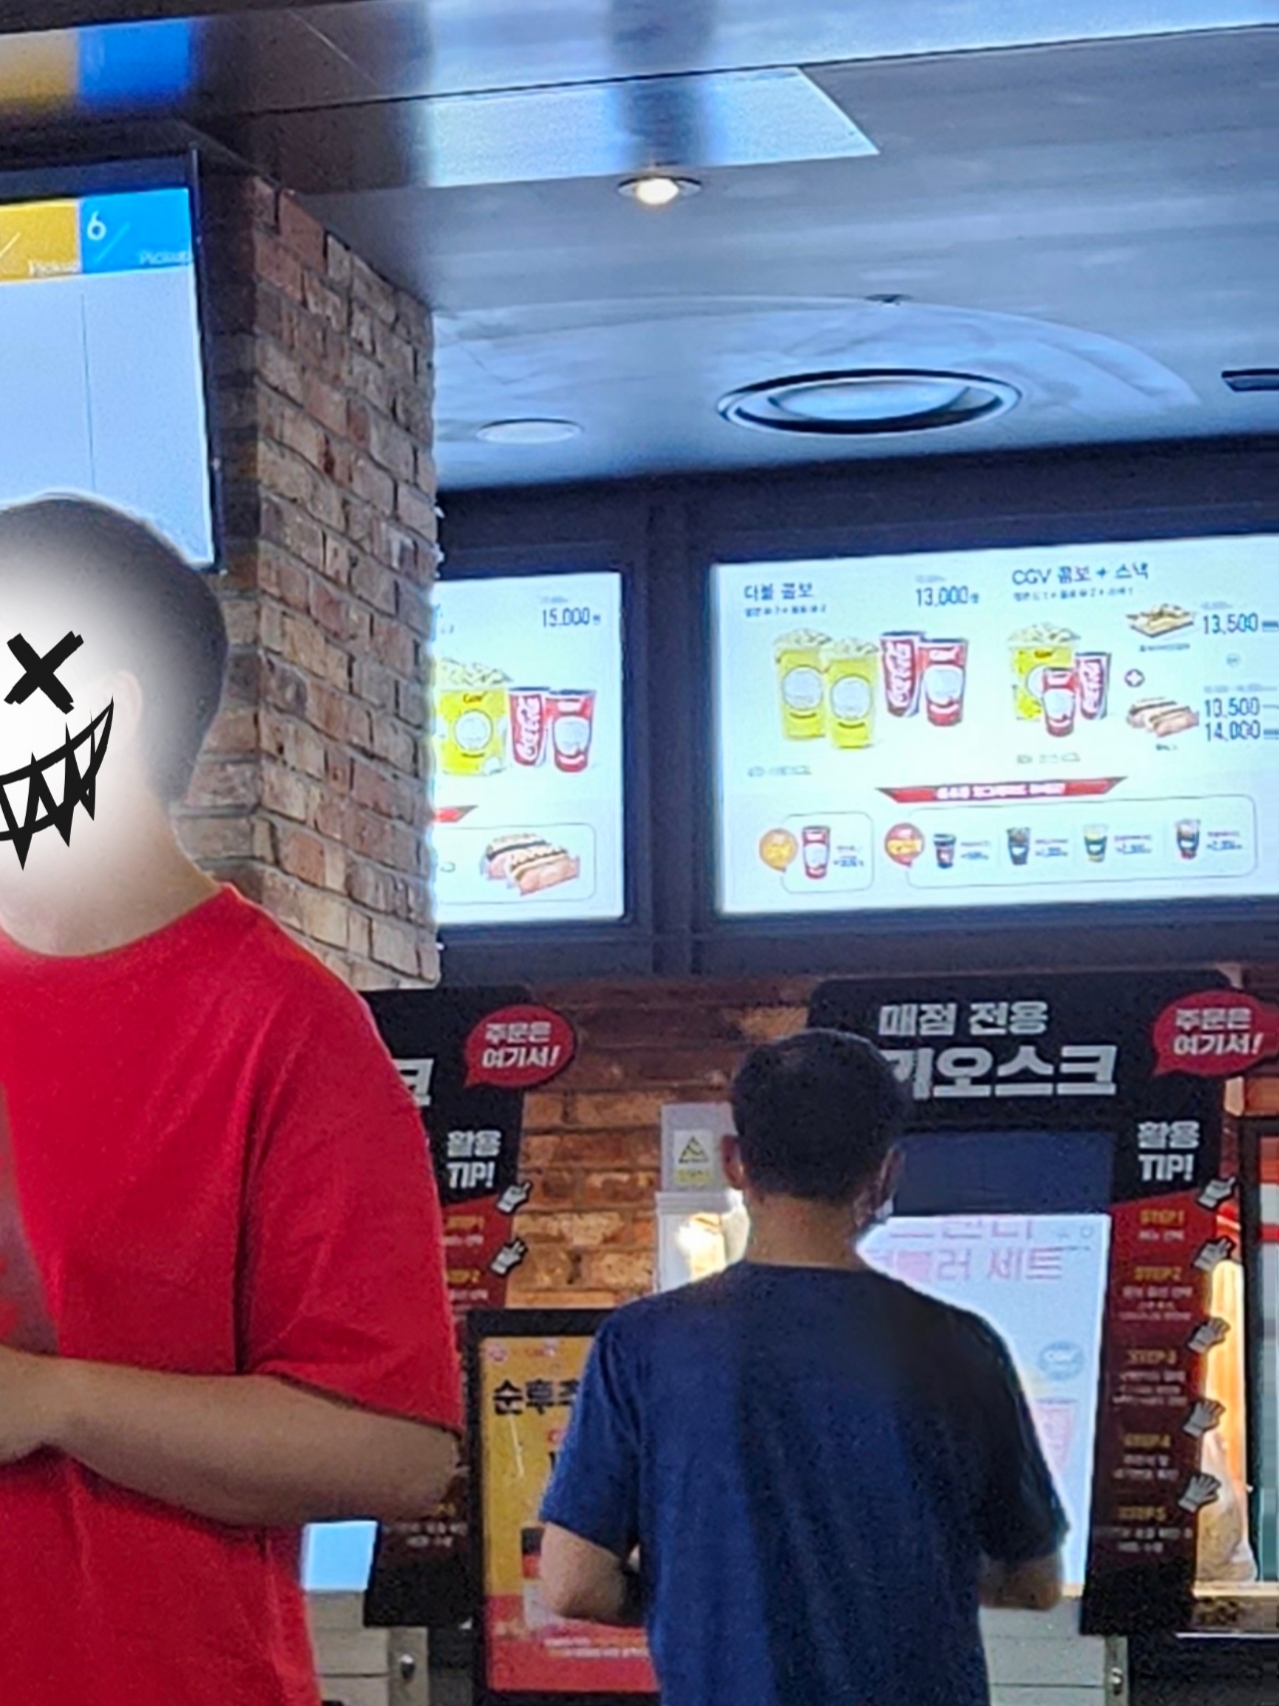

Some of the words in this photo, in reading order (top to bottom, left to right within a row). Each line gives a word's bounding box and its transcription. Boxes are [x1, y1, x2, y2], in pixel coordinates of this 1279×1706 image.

[86, 210, 107, 241] 6
[28, 258, 81, 276] Pickup
[138, 249, 194, 266] Pickup
[1011, 568, 1052, 587] CGV
[877, 1002, 958, 1037] 매점
[969, 1000, 1049, 1036] 전용
[1175, 1006, 1253, 1031] 주문은
[484, 1020, 552, 1045] 주문은
[1173, 1032, 1264, 1056] 여기서!
[481, 1045, 562, 1069] 여기서!
[446, 1129, 502, 1158] 활용
[1137, 1120, 1201, 1149] 활용
[445, 1161, 496, 1189] TIP!
[1137, 1153, 1195, 1182] TIP!
[988, 1248, 1063, 1281] 세트
